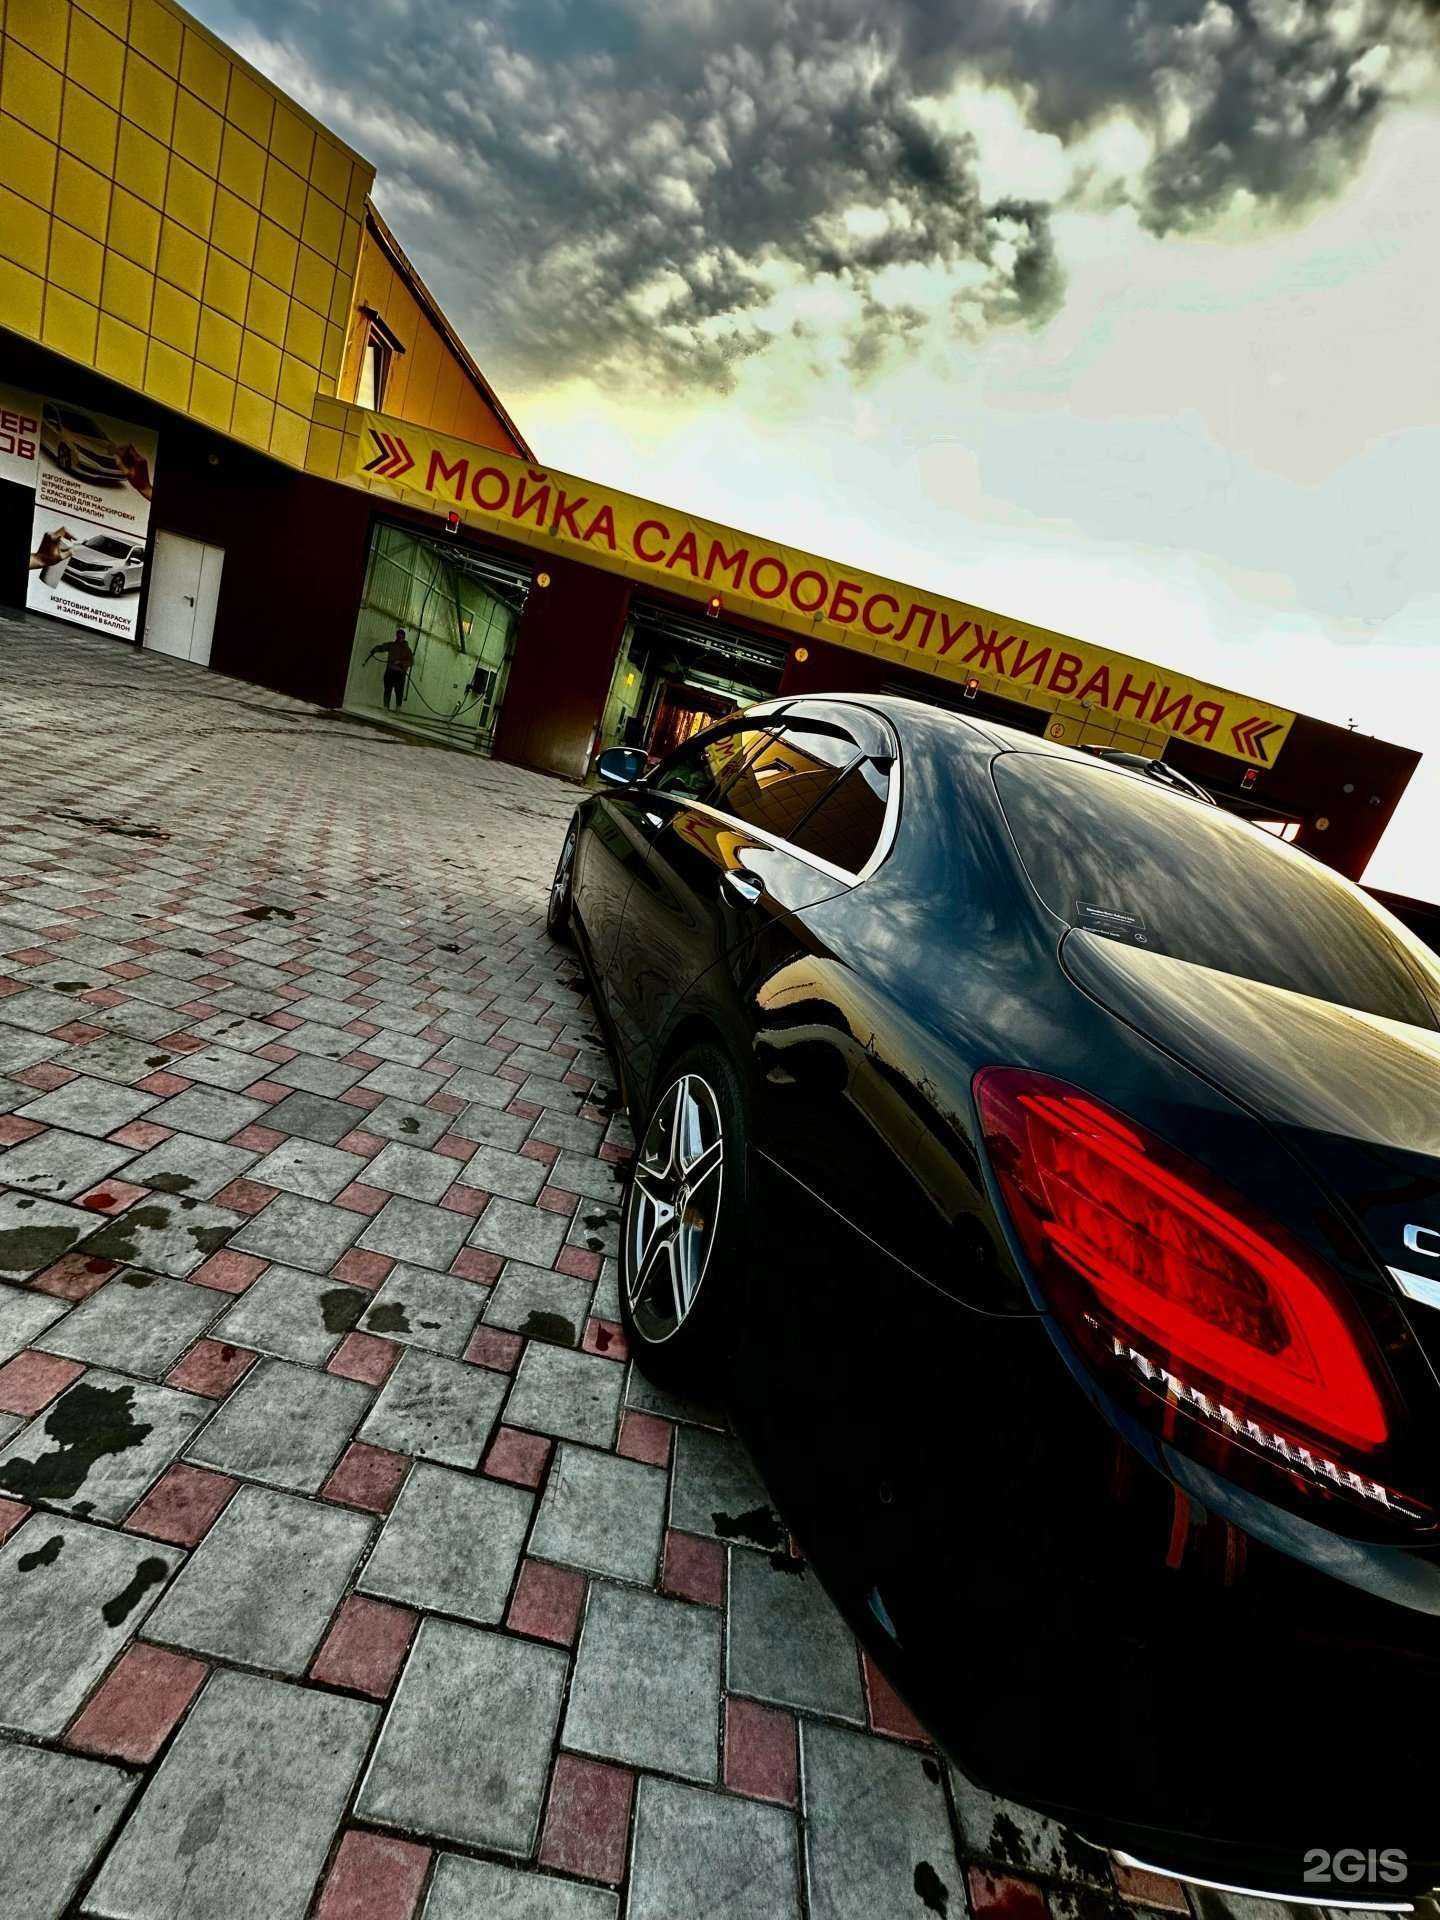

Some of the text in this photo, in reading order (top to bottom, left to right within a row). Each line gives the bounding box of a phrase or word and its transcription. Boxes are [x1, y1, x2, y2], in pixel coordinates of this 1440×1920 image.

[0, 408, 37, 434] ЕР
[41, 480, 103, 503] ШТРИХ-КОРРЕКТОР
[42, 473, 80, 489] ИЗГОТОВИМ
[40, 494, 67, 507] СКОЛОВ
[73, 505, 104, 519] ЦАРАПИН
[46, 488, 77, 502] КРАСКОЙ
[77, 498, 91, 507] ДЛЯ
[91, 503, 135, 521] МАСКИРОВКИ
[425, 449, 1225, 744] МОЙКА САМООБСЛУЖИВАНИЯ
[50, 595, 131, 625] ИЗГОТОВИМ АВТОКРАСКУ
[63, 606, 98, 621] ЗАПРАВИМ
[103, 620, 131, 632] БАЛЛОН
